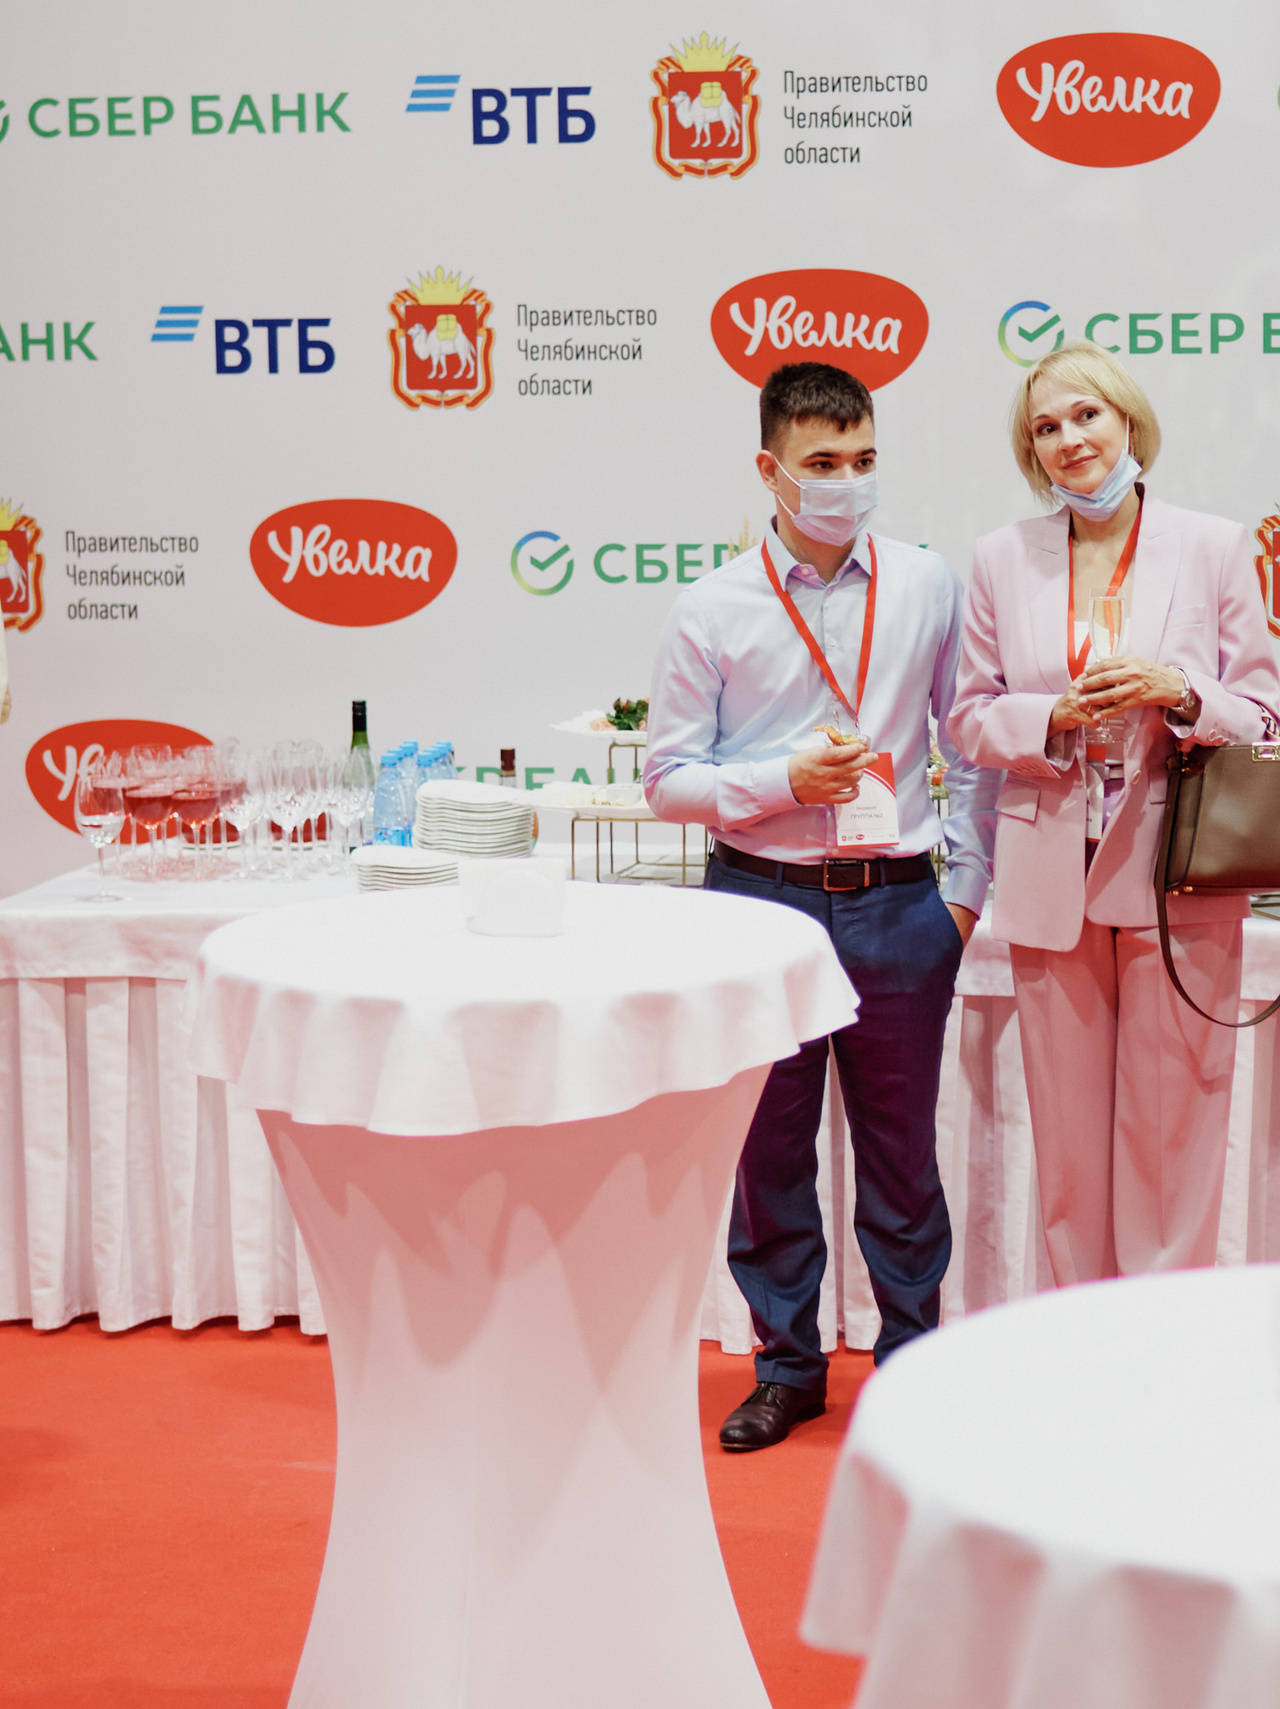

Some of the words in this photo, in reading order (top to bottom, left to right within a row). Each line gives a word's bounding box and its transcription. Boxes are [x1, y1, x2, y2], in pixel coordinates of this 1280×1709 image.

[783, 70, 928, 98] Правительство
[1015, 59, 1194, 122] Увелка
[28, 96, 174, 138] СБЕР
[191, 92, 351, 135] БАНК
[472, 86, 596, 145] ВТБ
[783, 104, 912, 129] Челябинской
[784, 140, 861, 165] области
[517, 303, 657, 331] Правительство
[728, 295, 903, 356] Увелка
[215, 318, 336, 375] ВТБ
[1085, 313, 1245, 355] СБЕР
[517, 338, 642, 362] Челябинской
[518, 373, 592, 396] области
[65, 530, 199, 556] Правительство
[267, 523, 433, 583] Увелка
[66, 564, 185, 587] Челябинской
[67, 598, 138, 620] области
